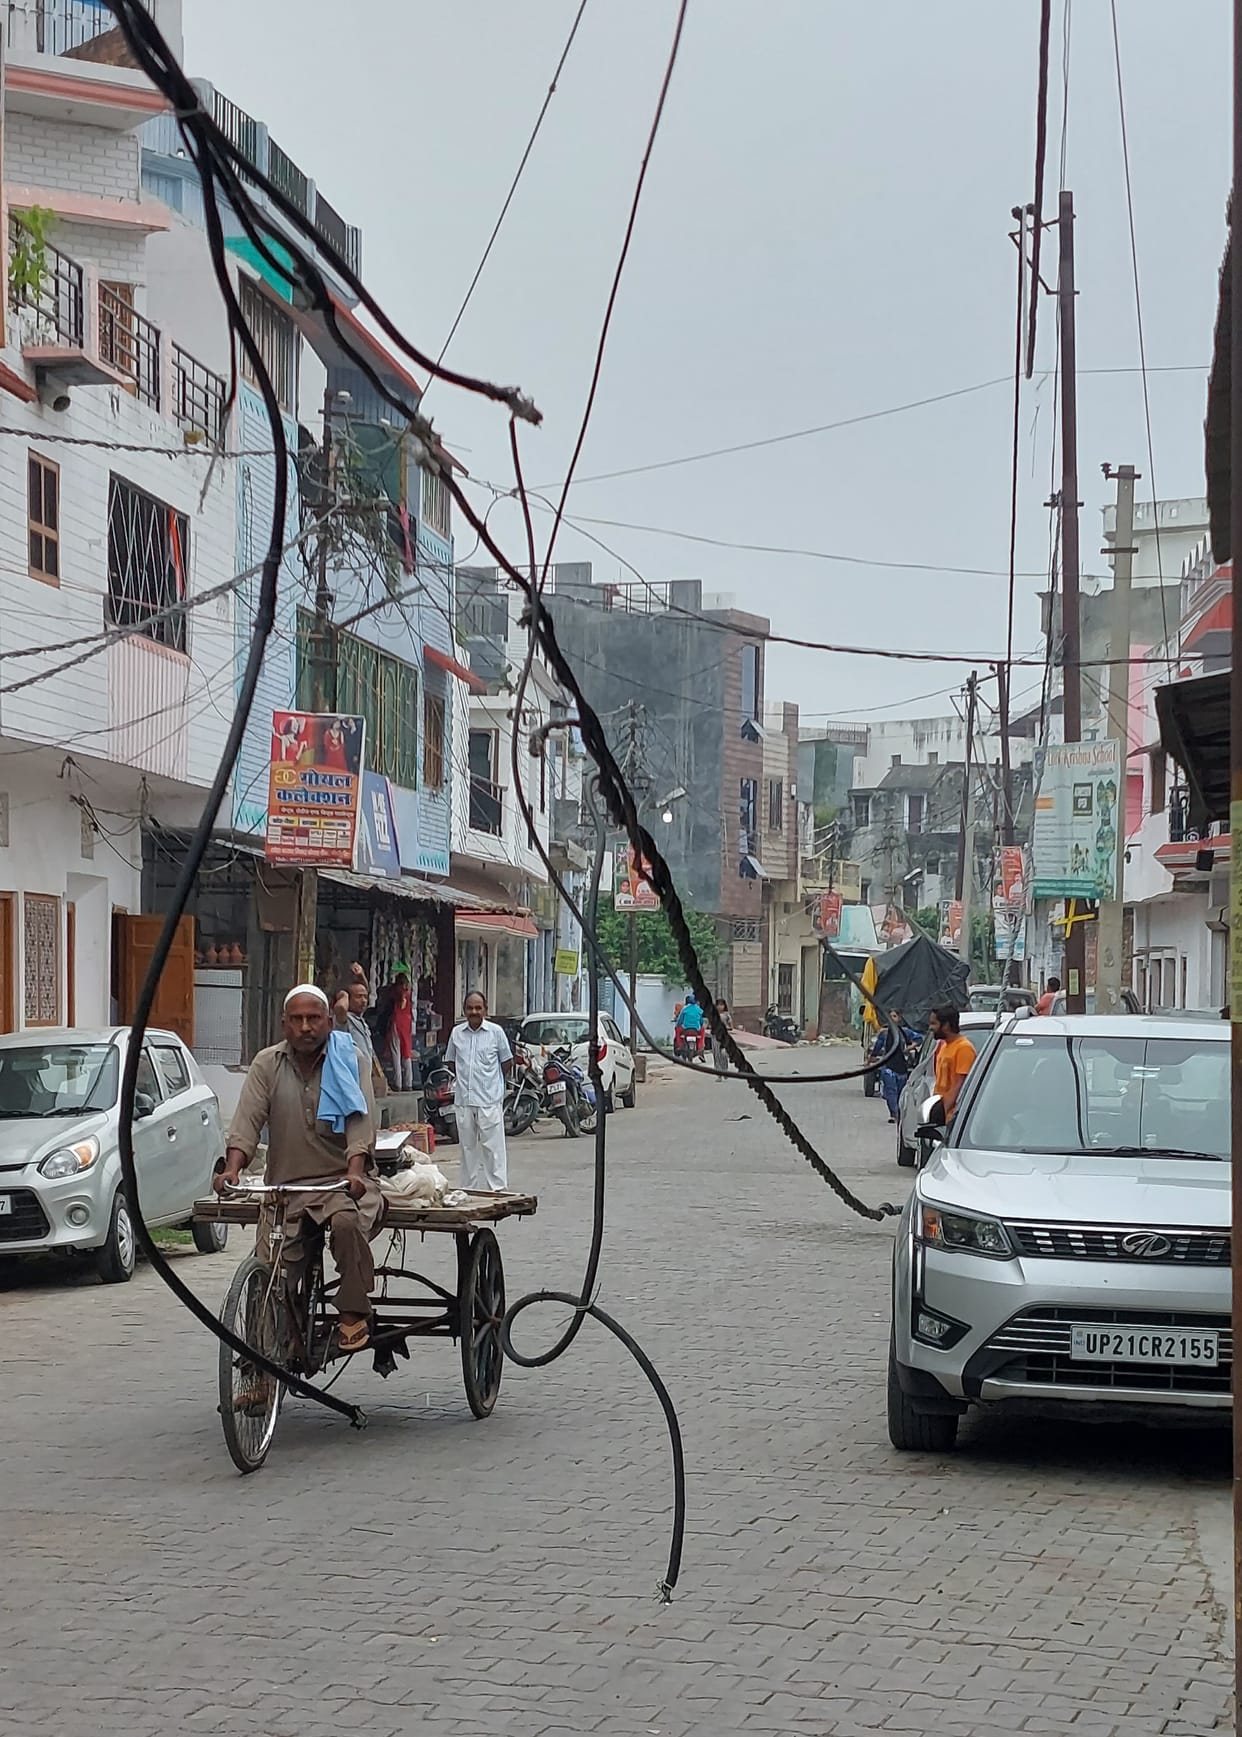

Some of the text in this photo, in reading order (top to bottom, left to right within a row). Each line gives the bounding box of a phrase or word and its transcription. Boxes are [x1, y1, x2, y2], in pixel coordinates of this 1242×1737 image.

[1092, 744, 1116, 766] School
[299, 768, 352, 787] गोयल
[275, 786, 353, 806] कलेक्शन
[1086, 1333, 1215, 1360] UP21CR2155
